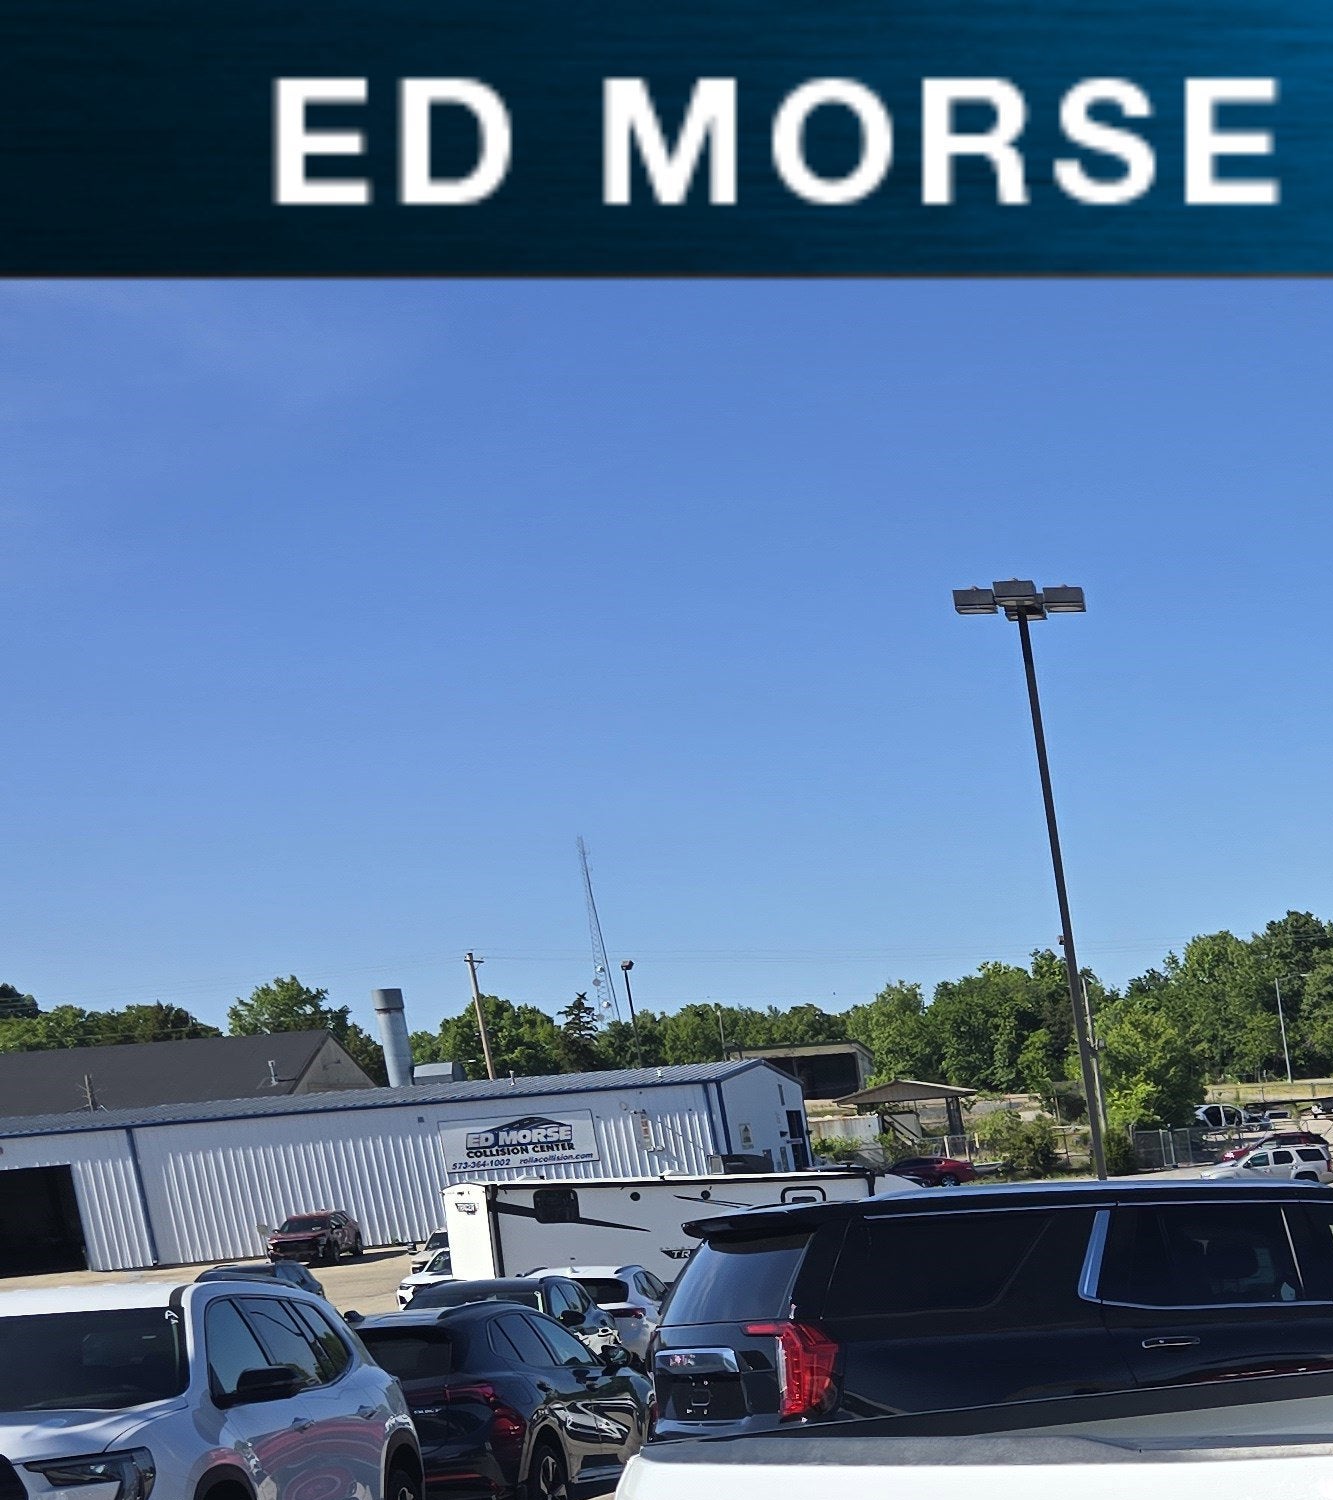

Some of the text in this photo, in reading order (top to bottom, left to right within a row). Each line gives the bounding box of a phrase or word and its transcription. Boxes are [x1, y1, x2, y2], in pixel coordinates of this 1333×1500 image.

[468, 1125, 573, 1148] ED MORSE
[466, 1141, 575, 1159] COLLISION CENTER
[451, 1158, 511, 1170] 573-364-1002
